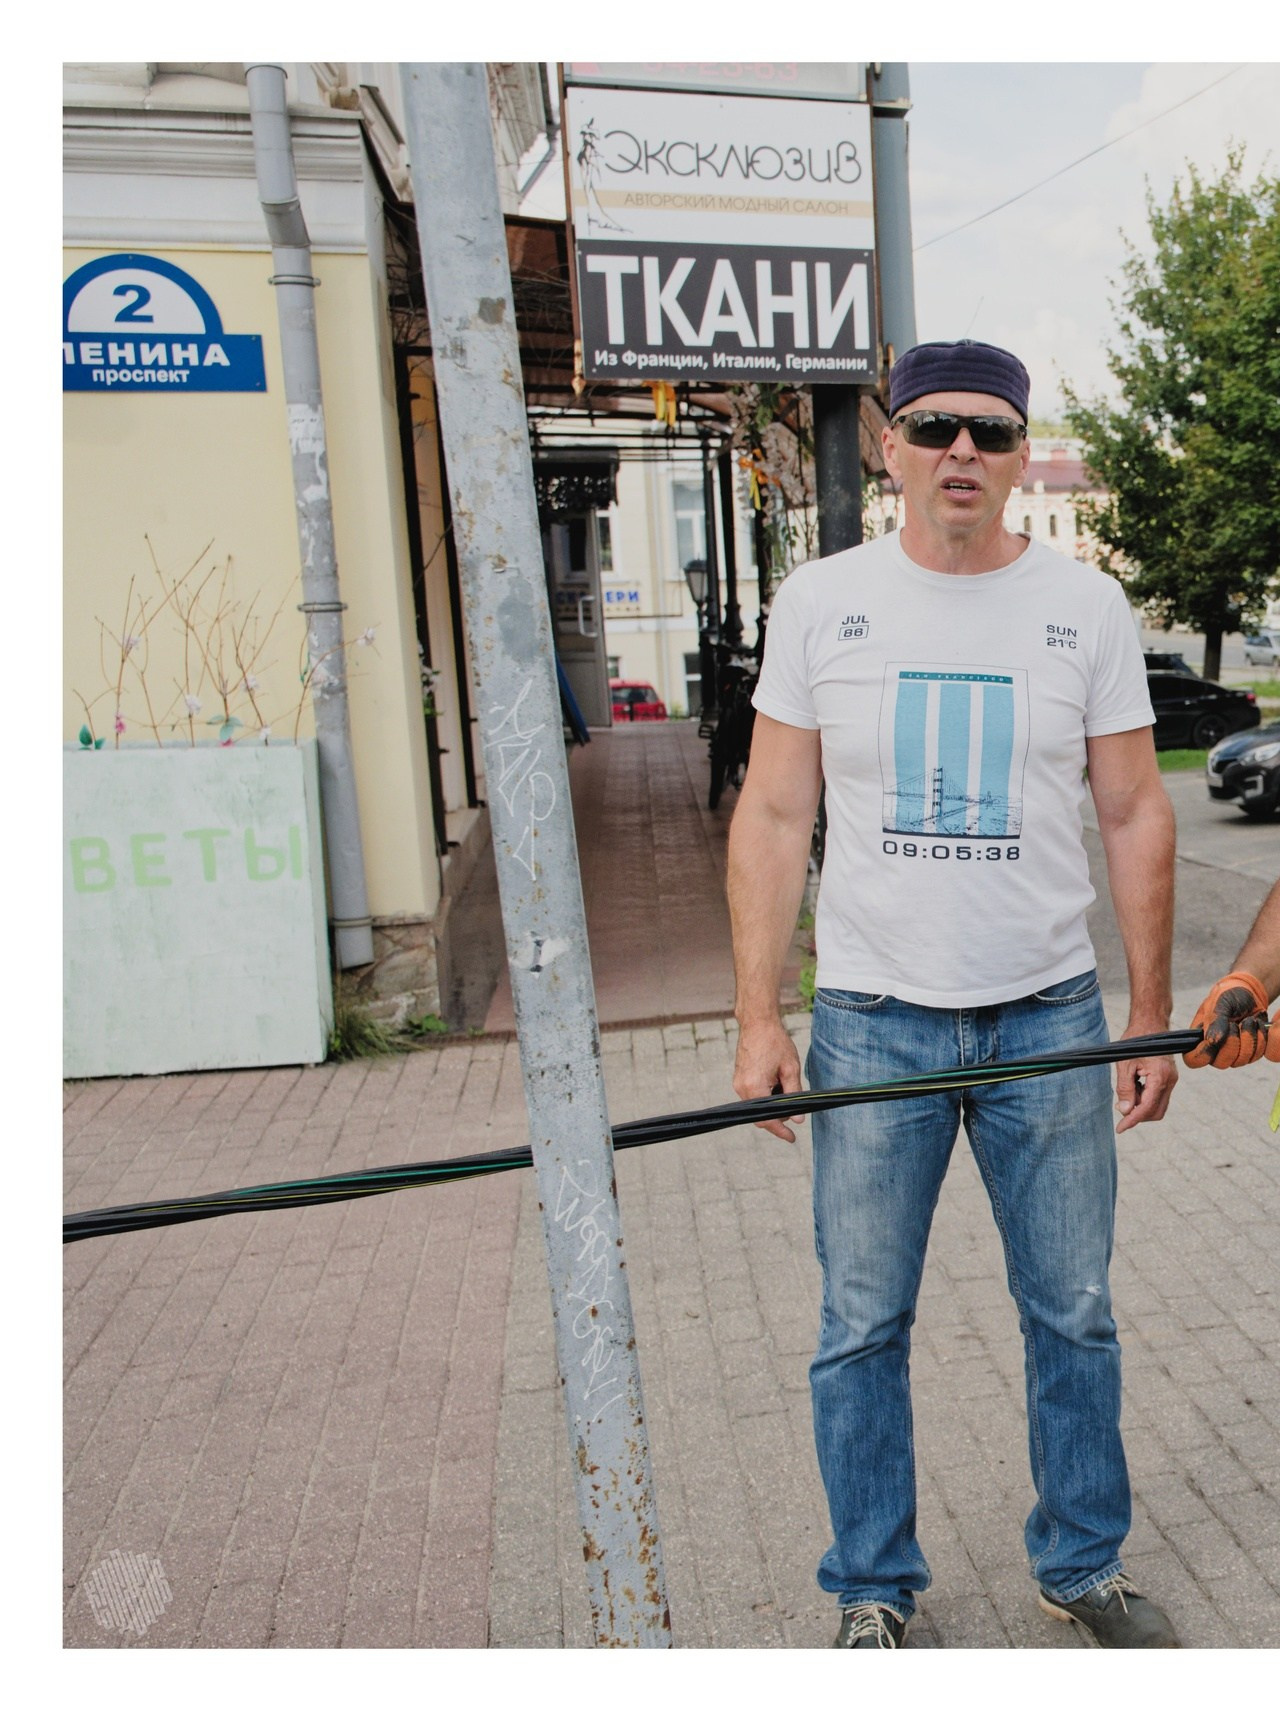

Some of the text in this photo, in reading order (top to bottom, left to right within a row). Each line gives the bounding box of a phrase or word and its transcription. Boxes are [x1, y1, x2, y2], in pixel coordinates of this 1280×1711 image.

[624, 192, 849, 214] АВТОРСКИЙ МОДНЫЙ САЛОН
[112, 284, 154, 323] 2
[586, 254, 870, 350] ТКАНИ
[594, 350, 868, 372] Из Франции, Италии, Германии
[92, 369, 190, 386] проспект
[841, 615, 870, 625] JUL
[1046, 624, 1077, 638] SUN
[882, 840, 1020, 861] 09:05:38
